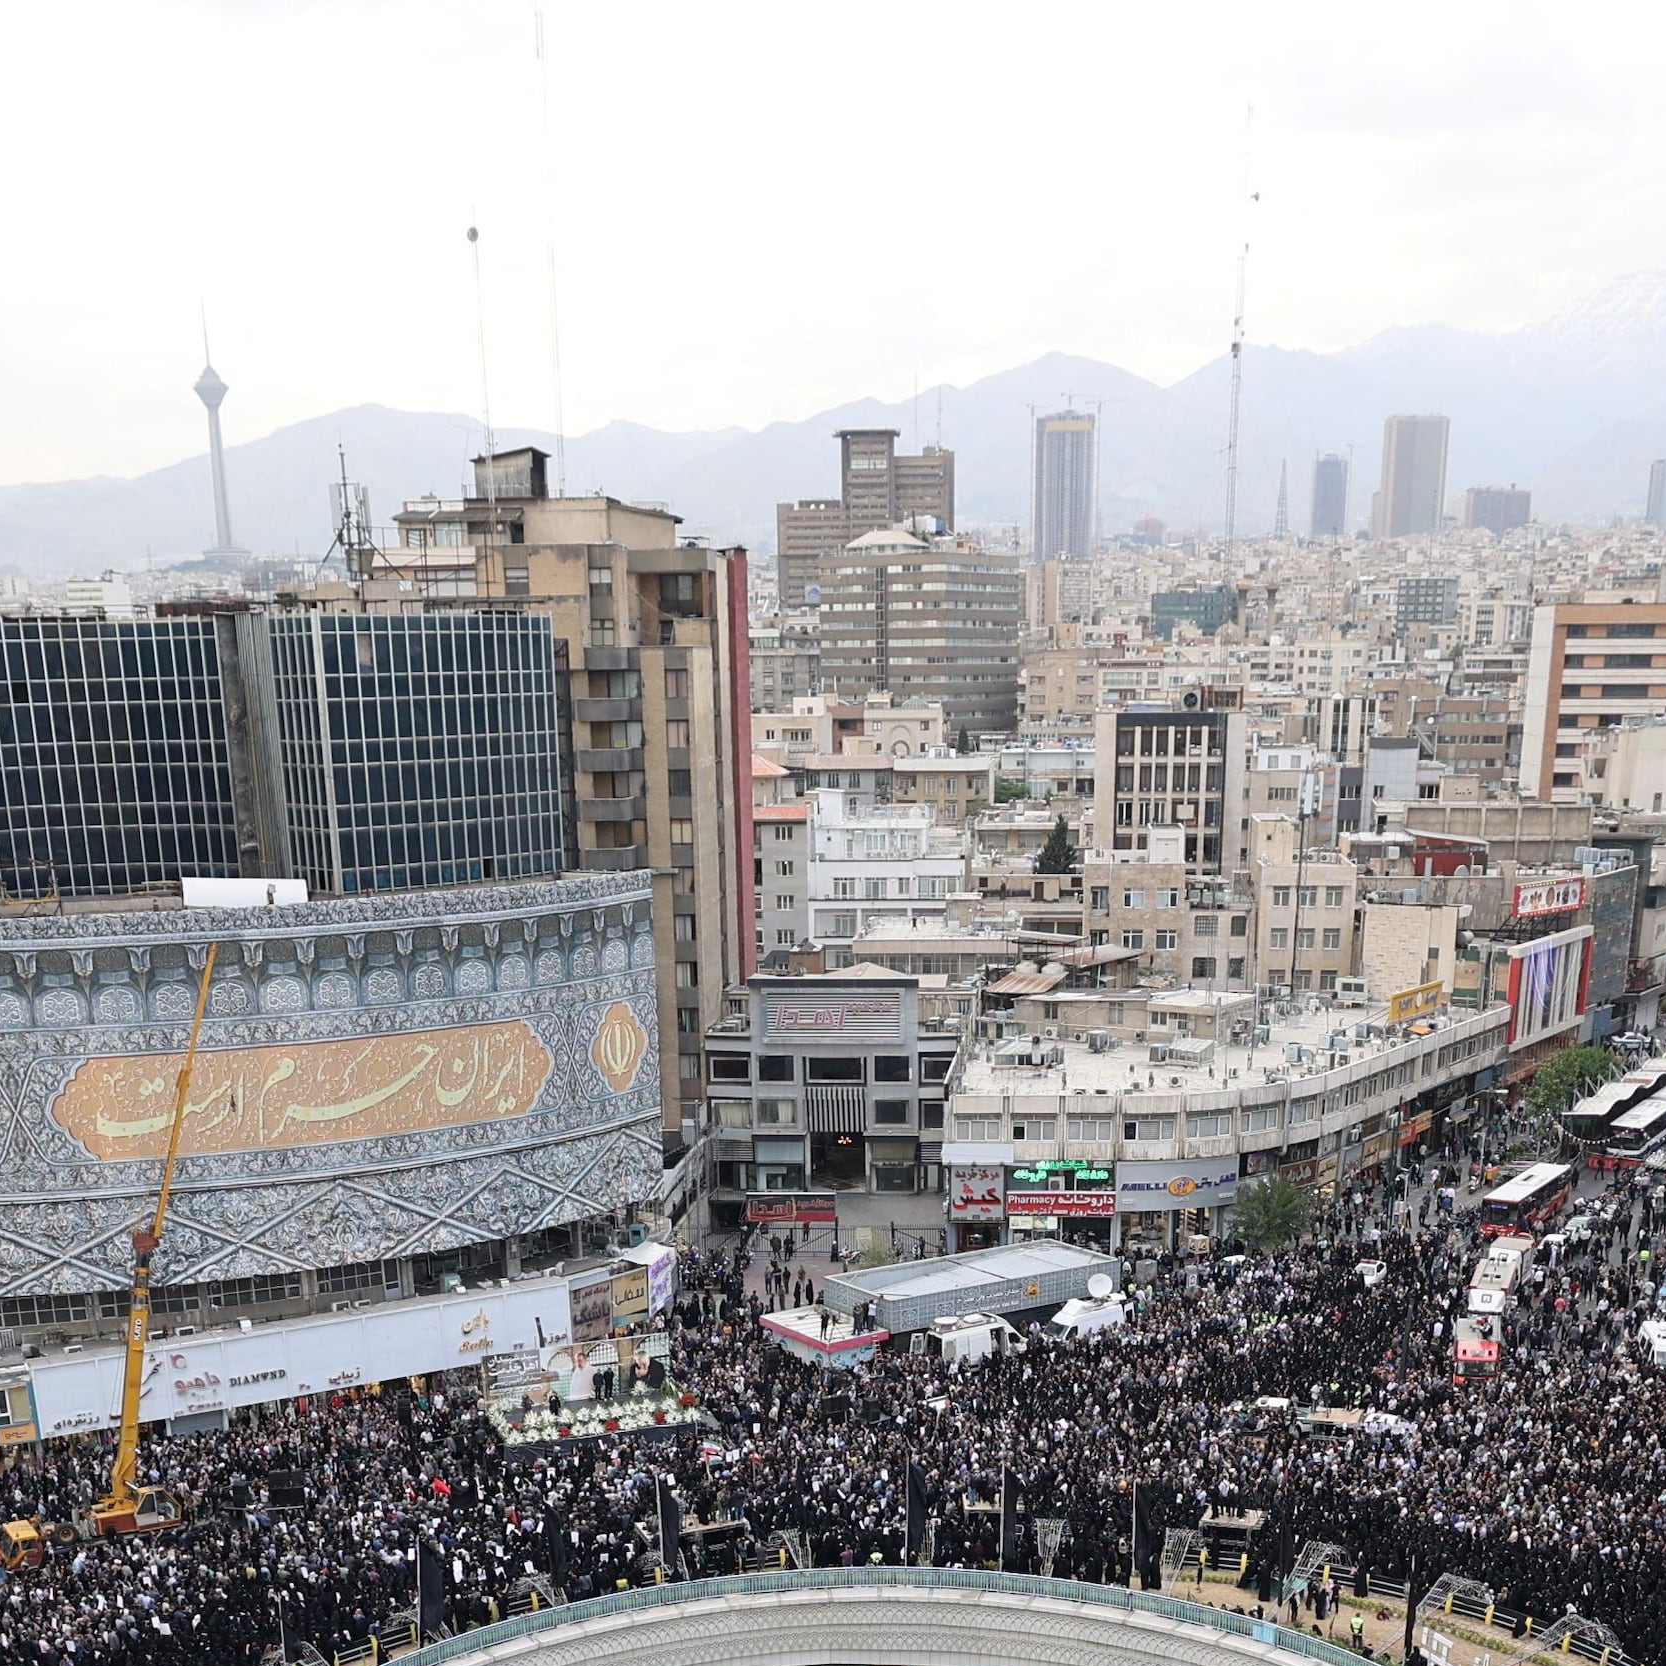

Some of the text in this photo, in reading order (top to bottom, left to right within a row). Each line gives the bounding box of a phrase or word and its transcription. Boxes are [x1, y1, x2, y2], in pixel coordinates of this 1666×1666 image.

[952, 1184, 1002, 1214] کیش
[1008, 1194, 1056, 1206] Pharmacy
[1058, 1193, 1115, 1208] داروخانه
[133, 1318, 142, 1341] KATO
